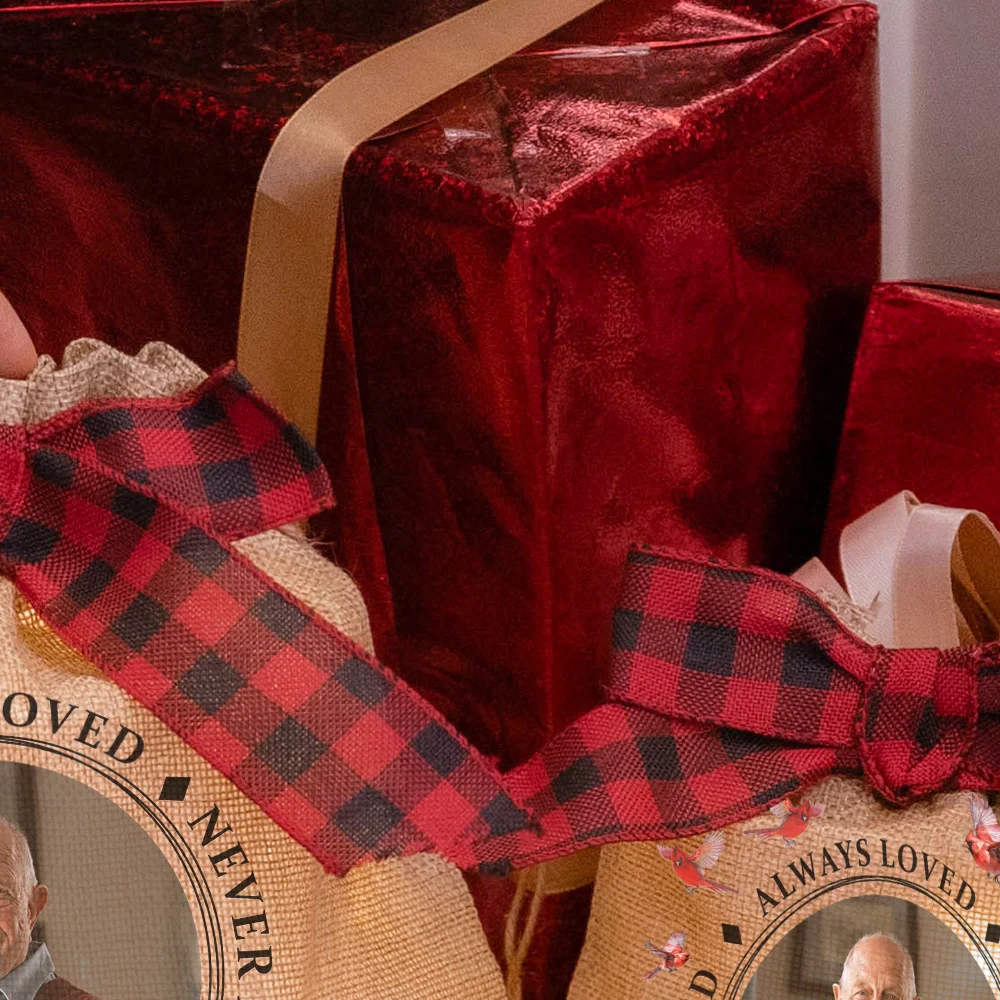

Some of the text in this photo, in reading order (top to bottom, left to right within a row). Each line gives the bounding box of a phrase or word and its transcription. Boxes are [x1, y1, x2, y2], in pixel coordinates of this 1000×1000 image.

[187, 803, 273, 981] NEVER
[755, 838, 977, 918] ALWAYS LOVED
